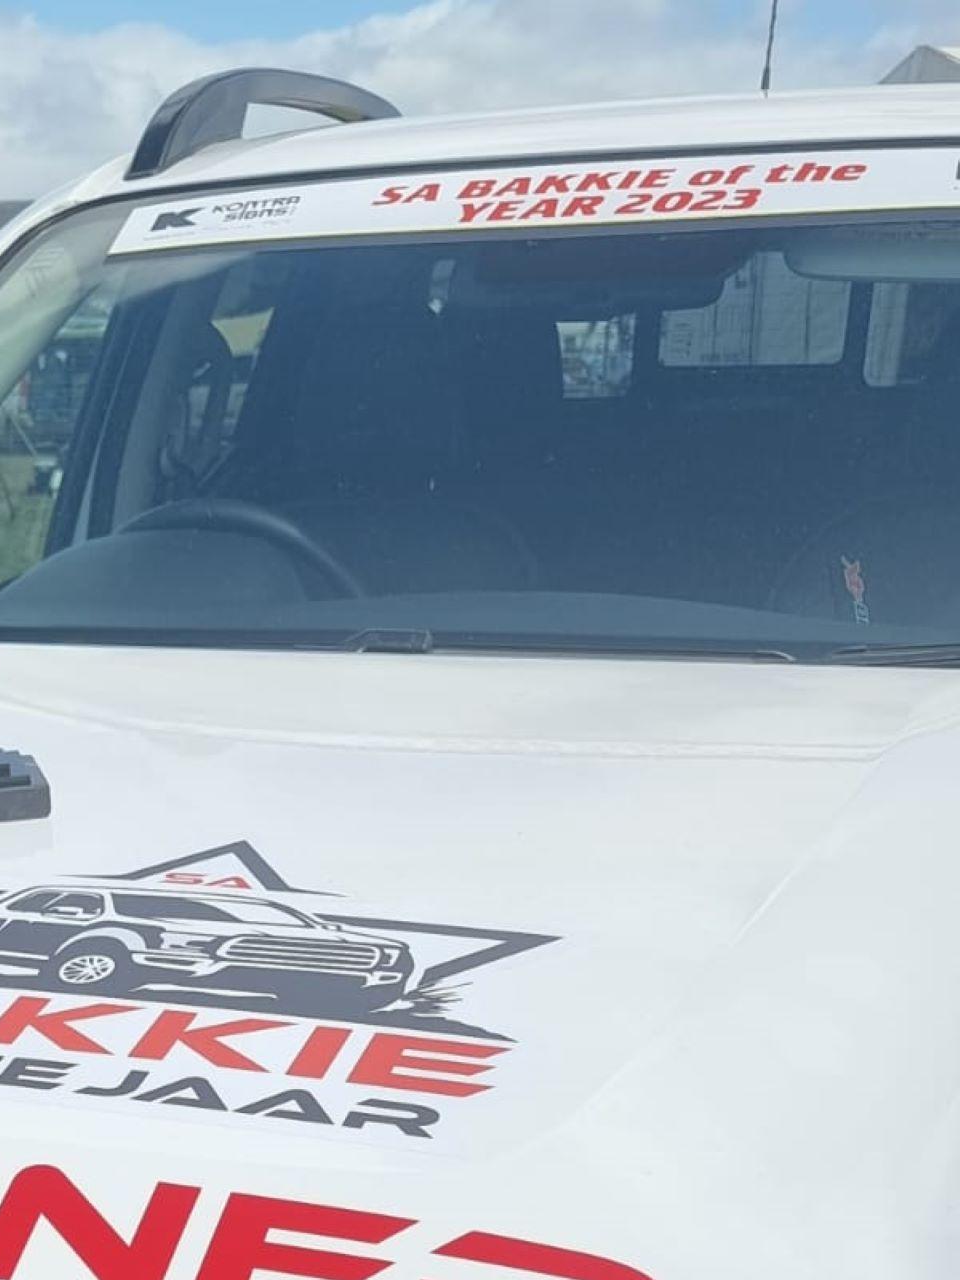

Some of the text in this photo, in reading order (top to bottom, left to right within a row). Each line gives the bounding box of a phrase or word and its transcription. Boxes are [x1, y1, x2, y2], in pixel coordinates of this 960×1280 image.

[373, 161, 868, 206] SA BAKKIE of the
[457, 188, 763, 223] YEAR 2023
[160, 872, 253, 891] SA
[74, 1070, 442, 1140] JAAR
